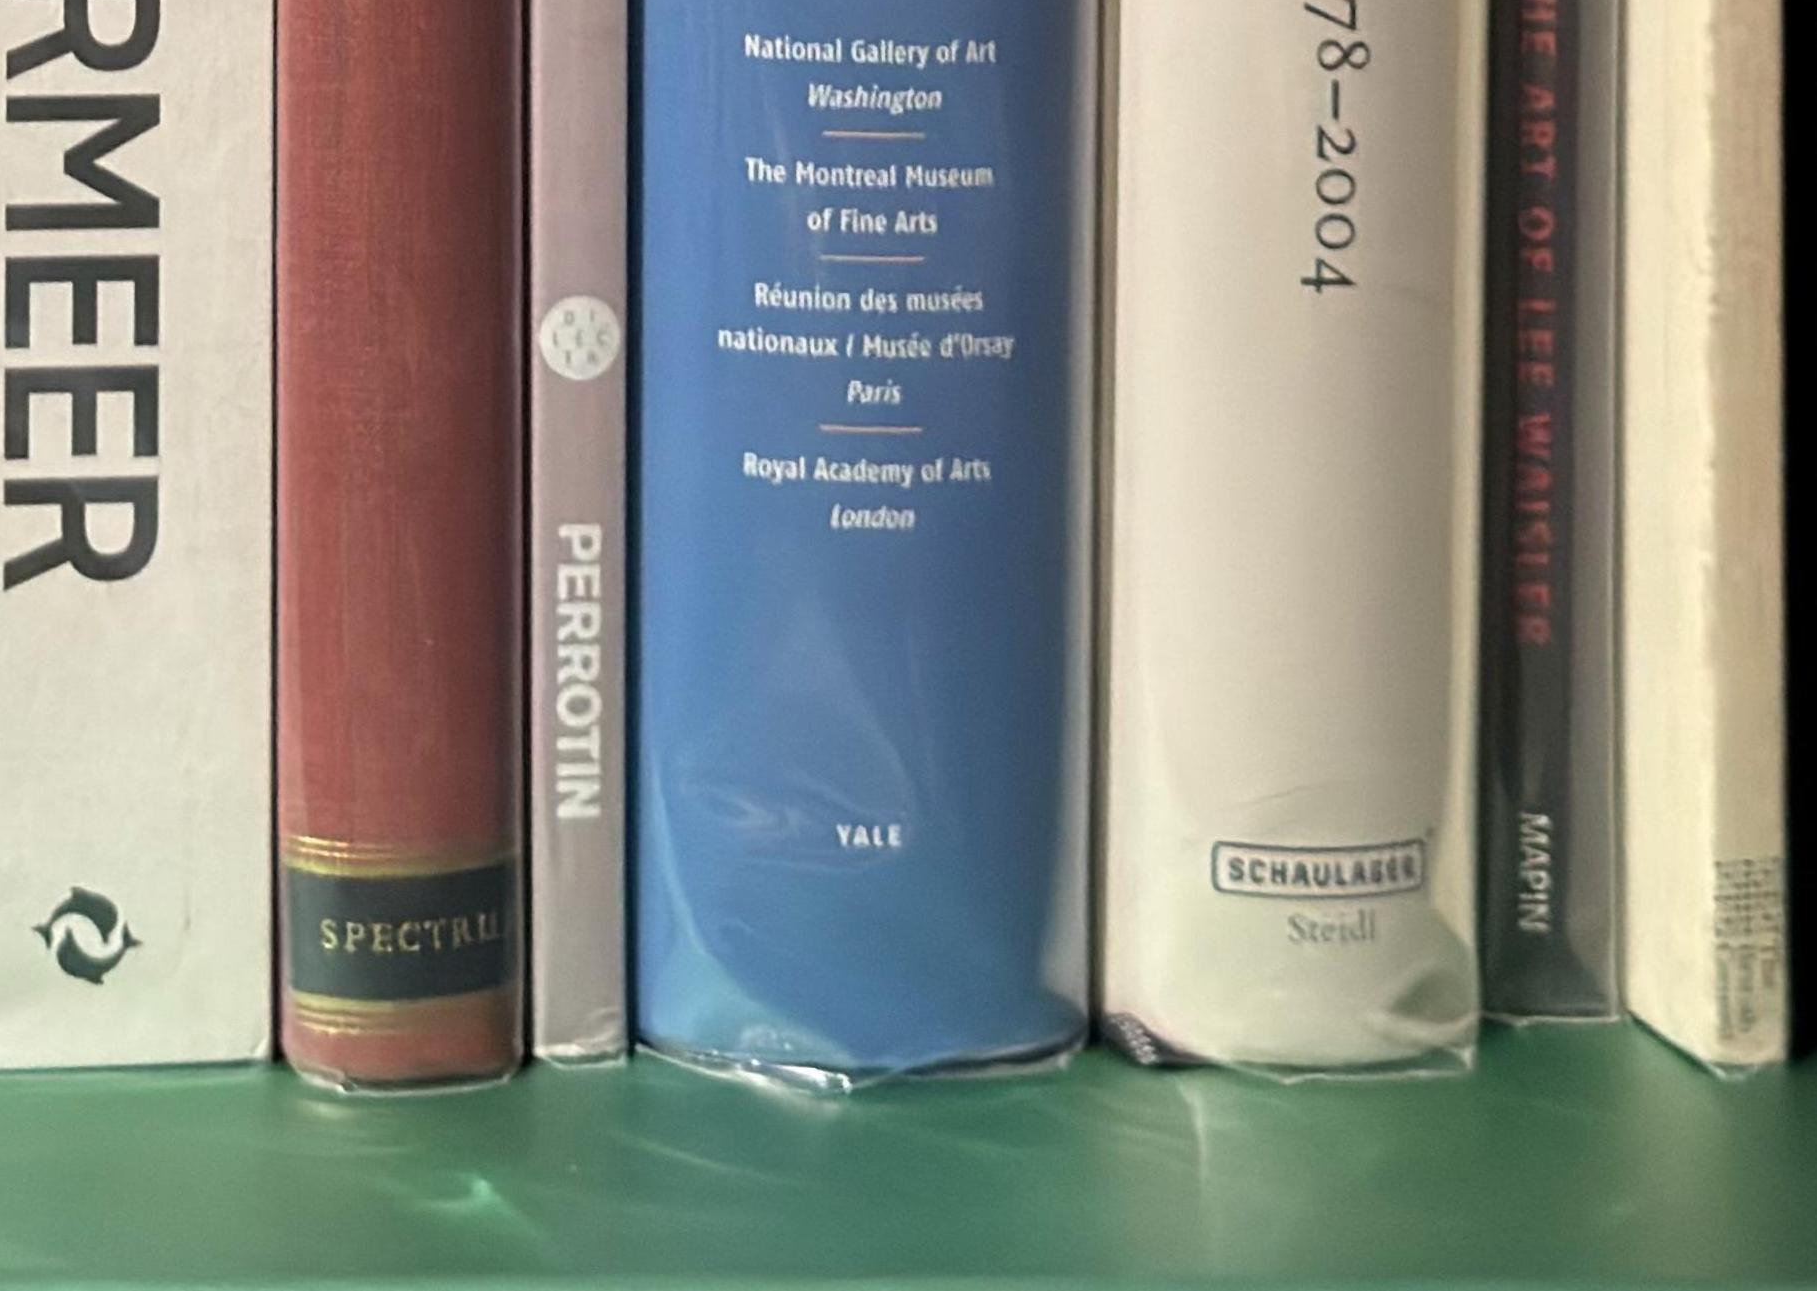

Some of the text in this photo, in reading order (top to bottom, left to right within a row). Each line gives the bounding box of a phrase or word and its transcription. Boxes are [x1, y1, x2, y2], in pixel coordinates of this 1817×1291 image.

[743, 34, 997, 70] National Gallery of Art
[807, 83, 942, 115] Washington
[1518, 83, 1557, 181] ART
[744, 157, 994, 188] The Montreal Museum
[807, 208, 938, 234] of Fine Arts
[1518, 206, 1554, 272] OF
[754, 281, 984, 312] Réunion des musées
[718, 326, 838, 356] nationaux
[862, 332, 932, 358] Musée
[847, 379, 902, 405] Paris
[743, 451, 991, 488] Royal Academy of Arts
[830, 504, 916, 530] London
[555, 524, 603, 820] PERROTIN
[835, 823, 902, 847] YALE
[1518, 810, 1554, 935] MAPIN
[1286, 908, 1377, 945] Steidl
